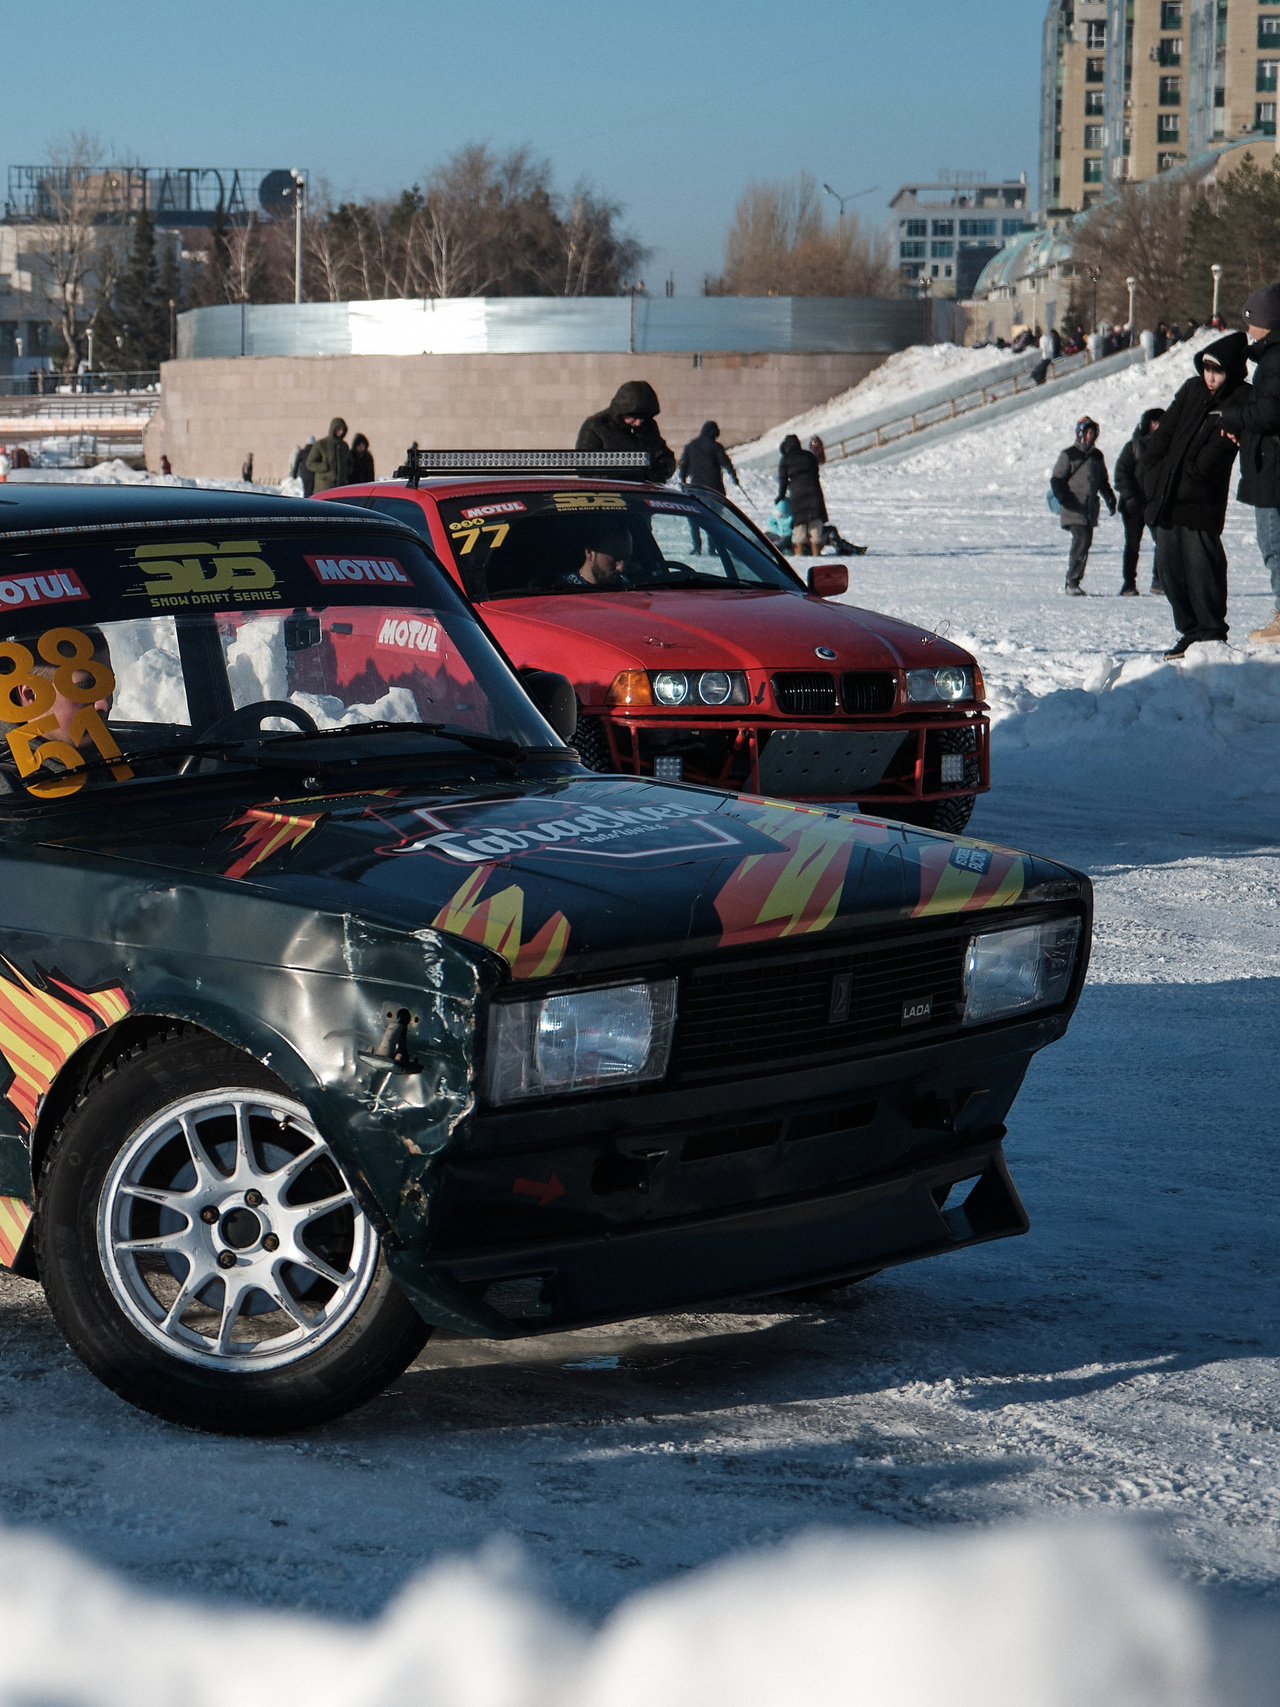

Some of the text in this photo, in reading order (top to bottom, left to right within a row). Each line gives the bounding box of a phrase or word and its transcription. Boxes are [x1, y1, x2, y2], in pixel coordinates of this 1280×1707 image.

[467, 502, 523, 518] MOTUL
[650, 500, 700, 513] MOTUL
[451, 523, 510, 556] 77
[315, 559, 407, 582] MOTUL
[150, 590, 282, 608] SNOW DRIFT SERIES
[378, 619, 438, 652] MOTUL
[6, 705, 135, 798] 51
[904, 1003, 930, 1019] LADA
